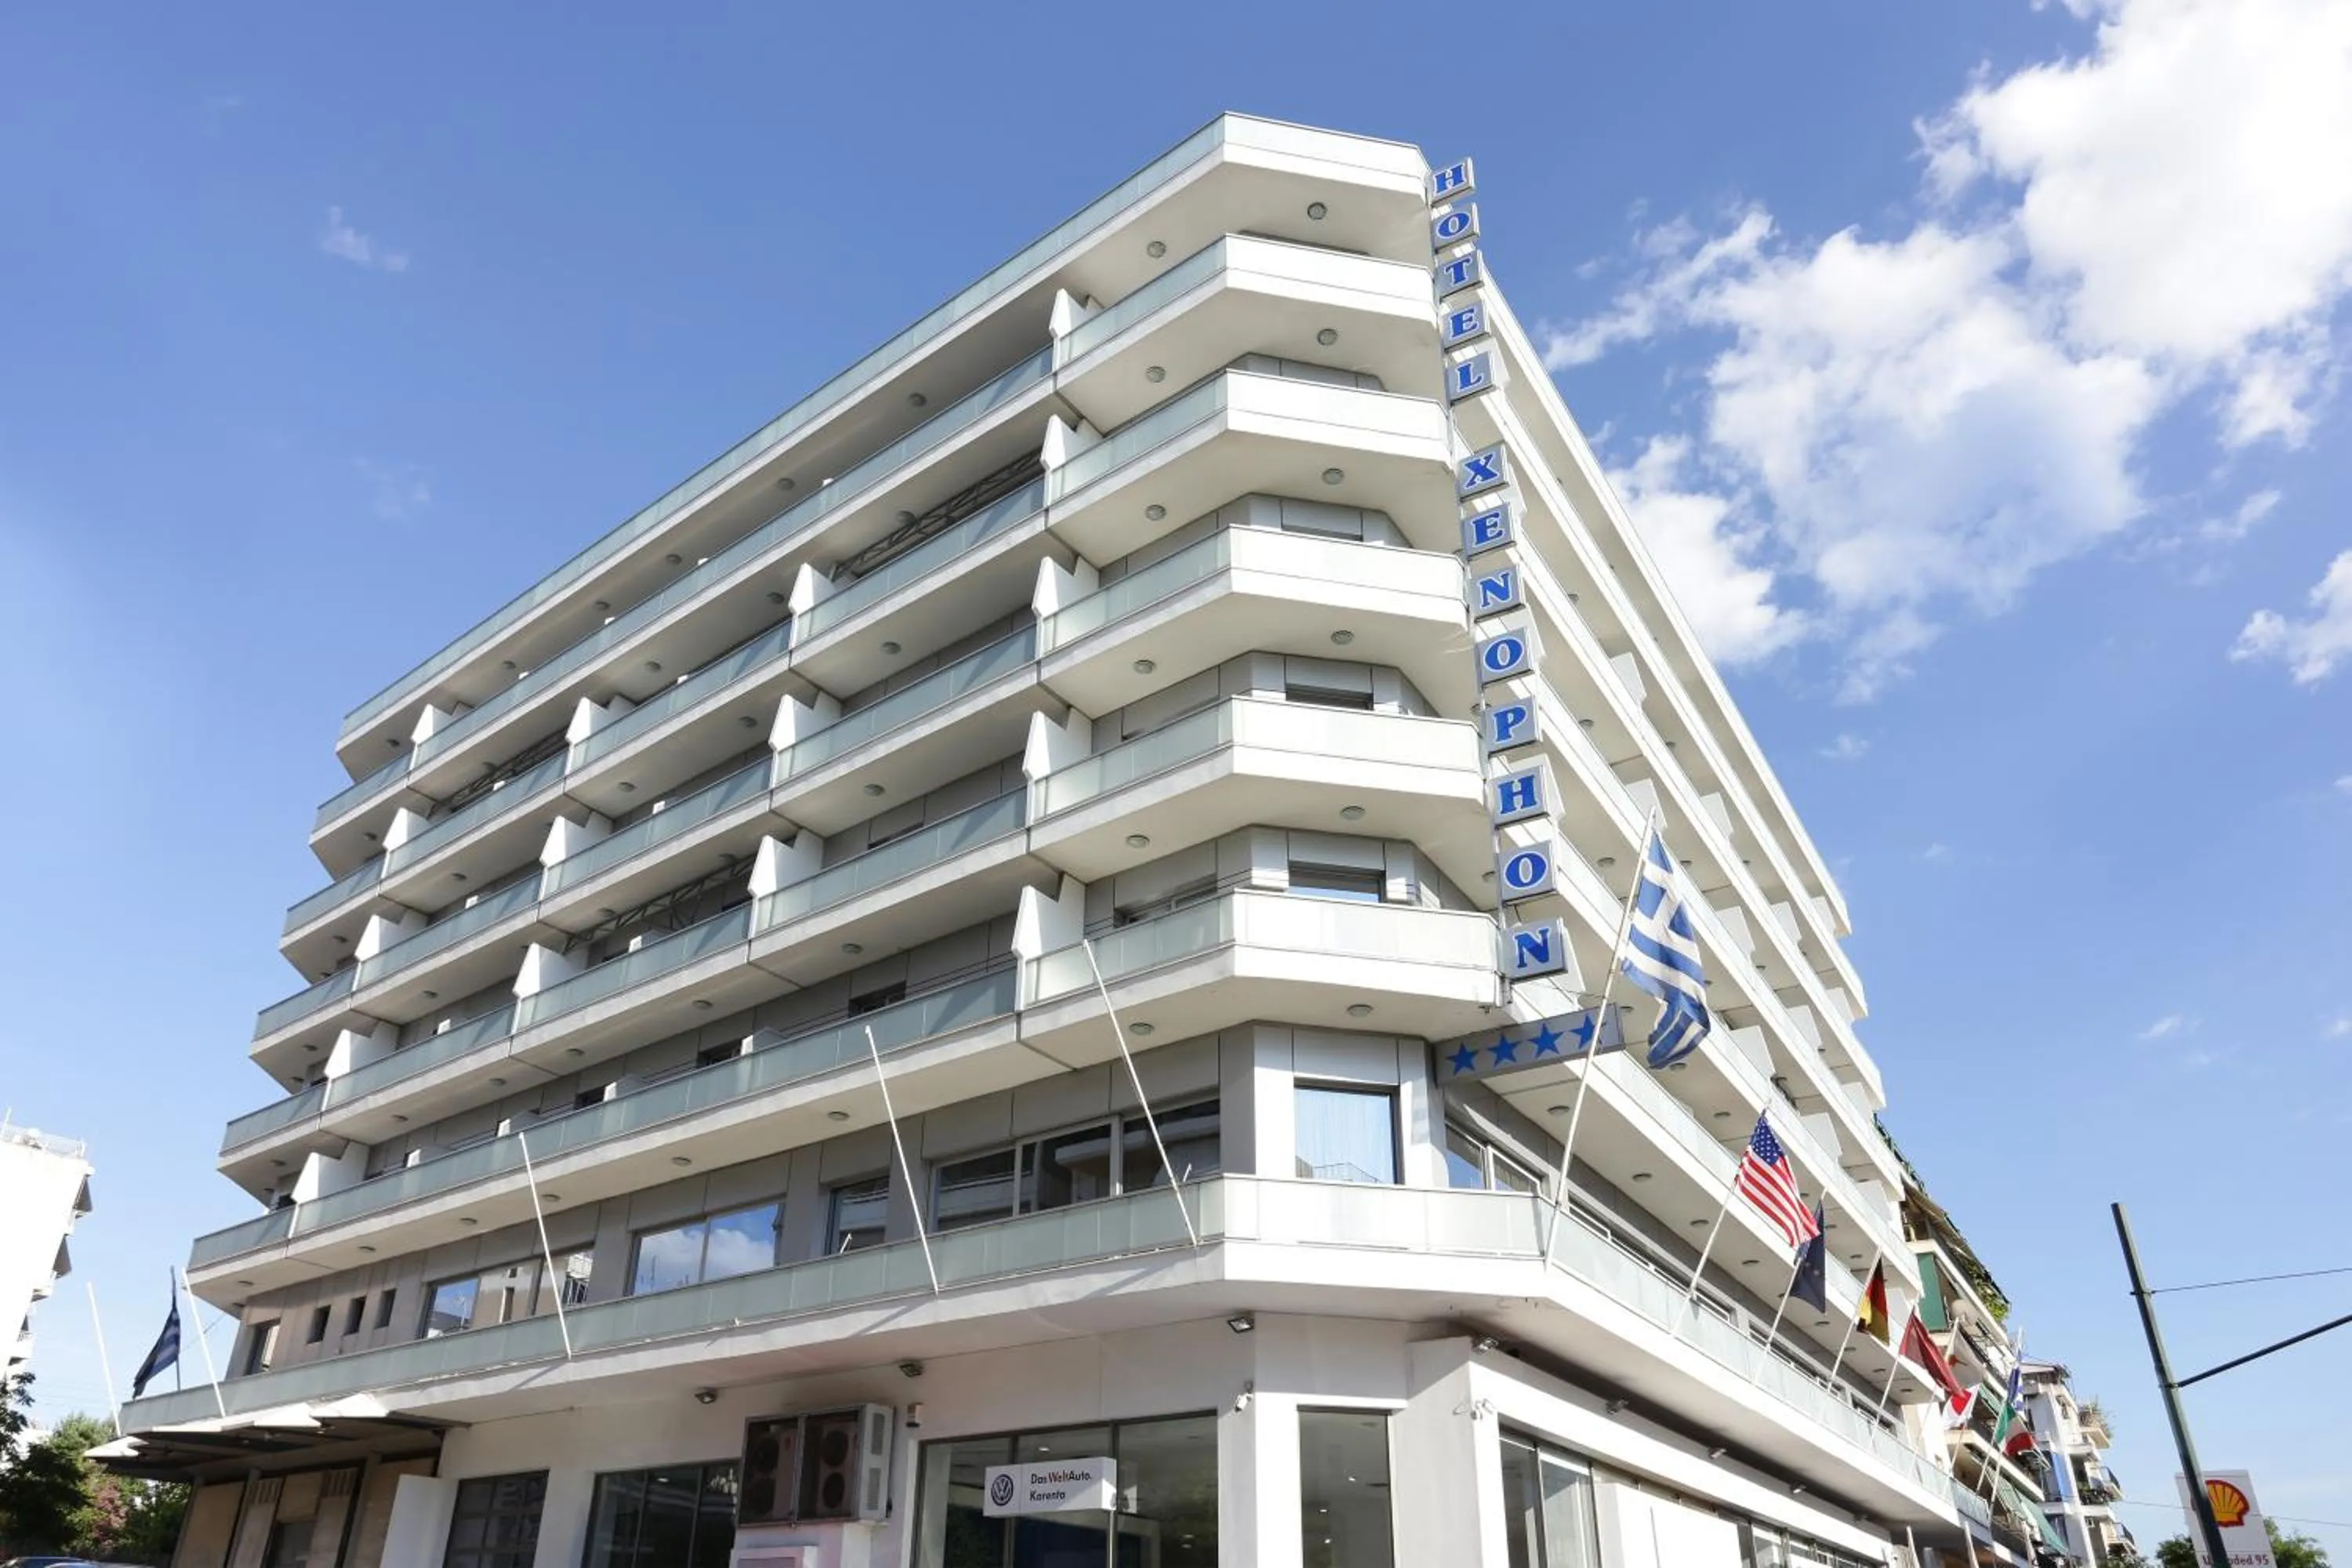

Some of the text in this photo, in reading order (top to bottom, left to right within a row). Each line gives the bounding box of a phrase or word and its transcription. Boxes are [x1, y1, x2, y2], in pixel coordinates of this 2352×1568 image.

[1433, 163, 1551, 969] HOTEL XENOPHON
[1030, 1473, 1047, 1484] Das
[2255, 1555, 2269, 1565] 95
